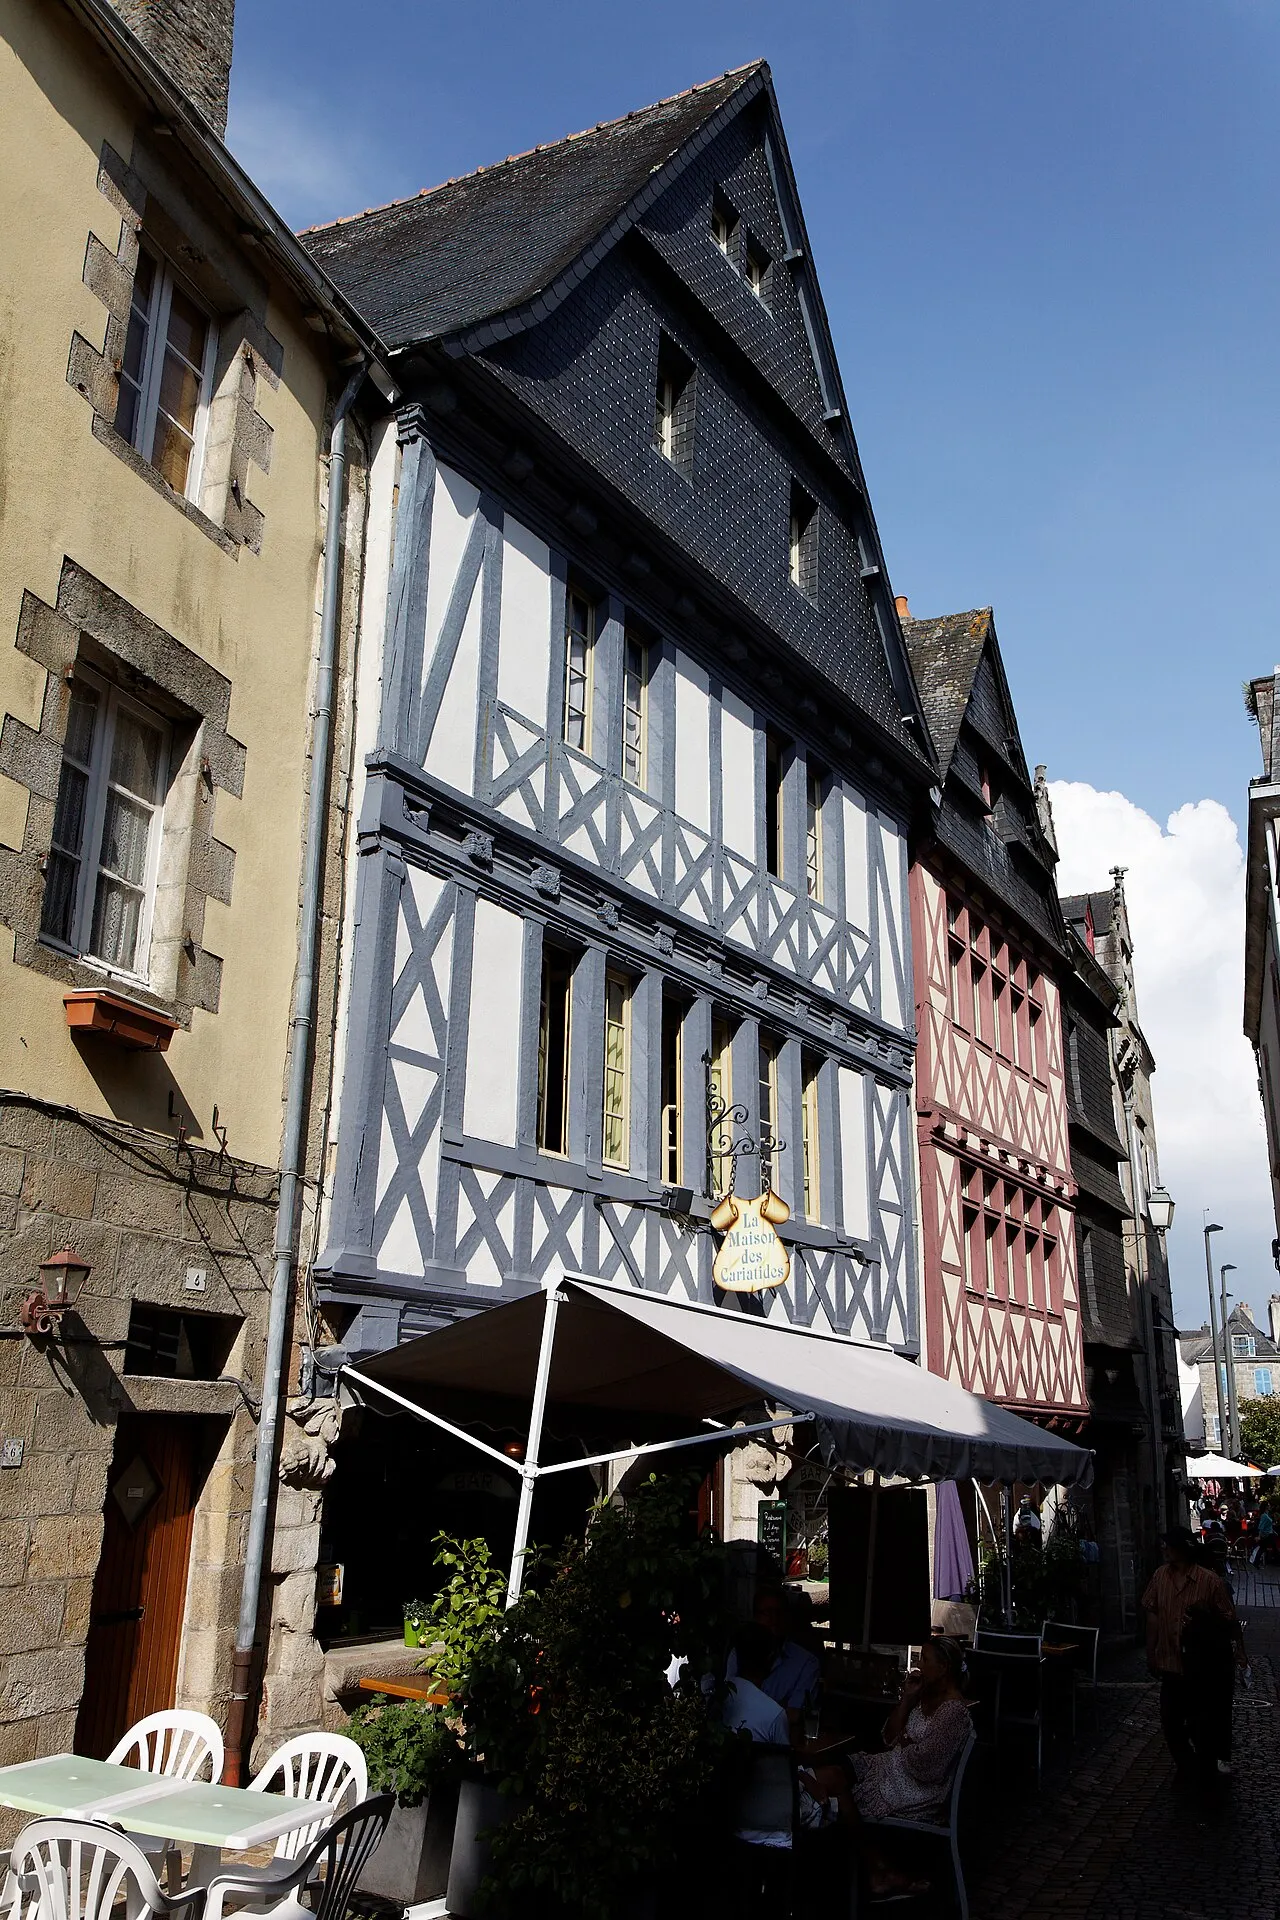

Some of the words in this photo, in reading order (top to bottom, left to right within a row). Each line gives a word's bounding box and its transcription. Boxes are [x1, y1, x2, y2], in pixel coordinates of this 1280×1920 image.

[743, 1213, 759, 1229] La
[728, 1231, 776, 1248] Maison
[741, 1249, 763, 1264] des
[720, 1264, 784, 1283] Cariatides
[801, 1467, 822, 1481] BAR
